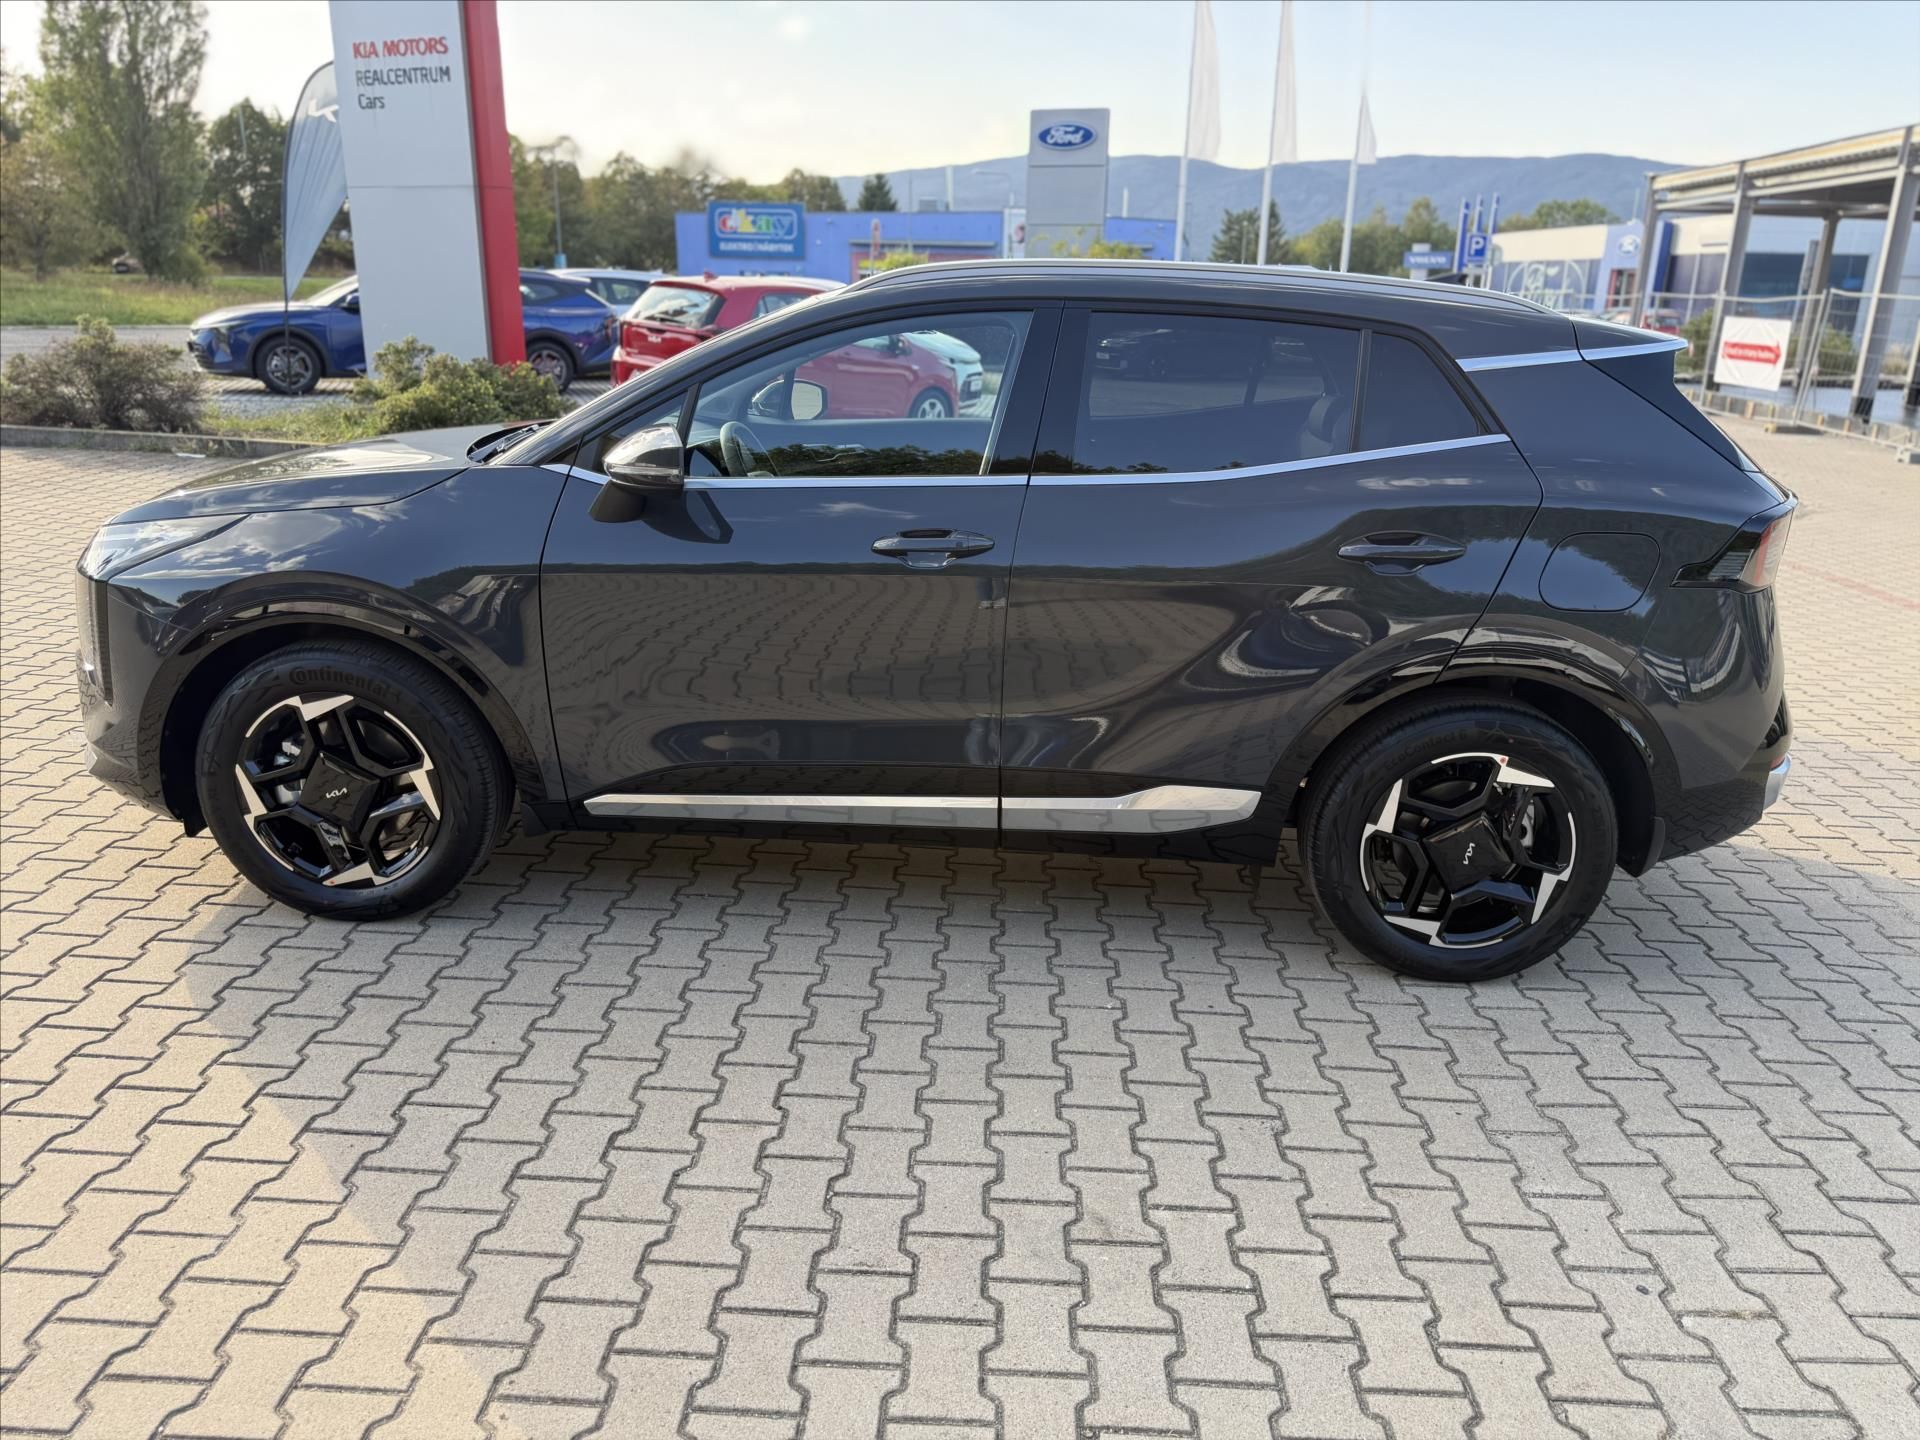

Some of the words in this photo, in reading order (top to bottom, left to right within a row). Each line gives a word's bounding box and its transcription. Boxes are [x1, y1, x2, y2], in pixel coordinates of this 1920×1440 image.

[353, 41, 380, 59] KIA
[383, 36, 449, 57] MOTORS
[355, 65, 451, 87] REALCENTRUM
[358, 93, 385, 110] Cars
[1046, 126, 1084, 144] Ford
[1470, 236, 1484, 255] P
[289, 666, 391, 696] Continental
